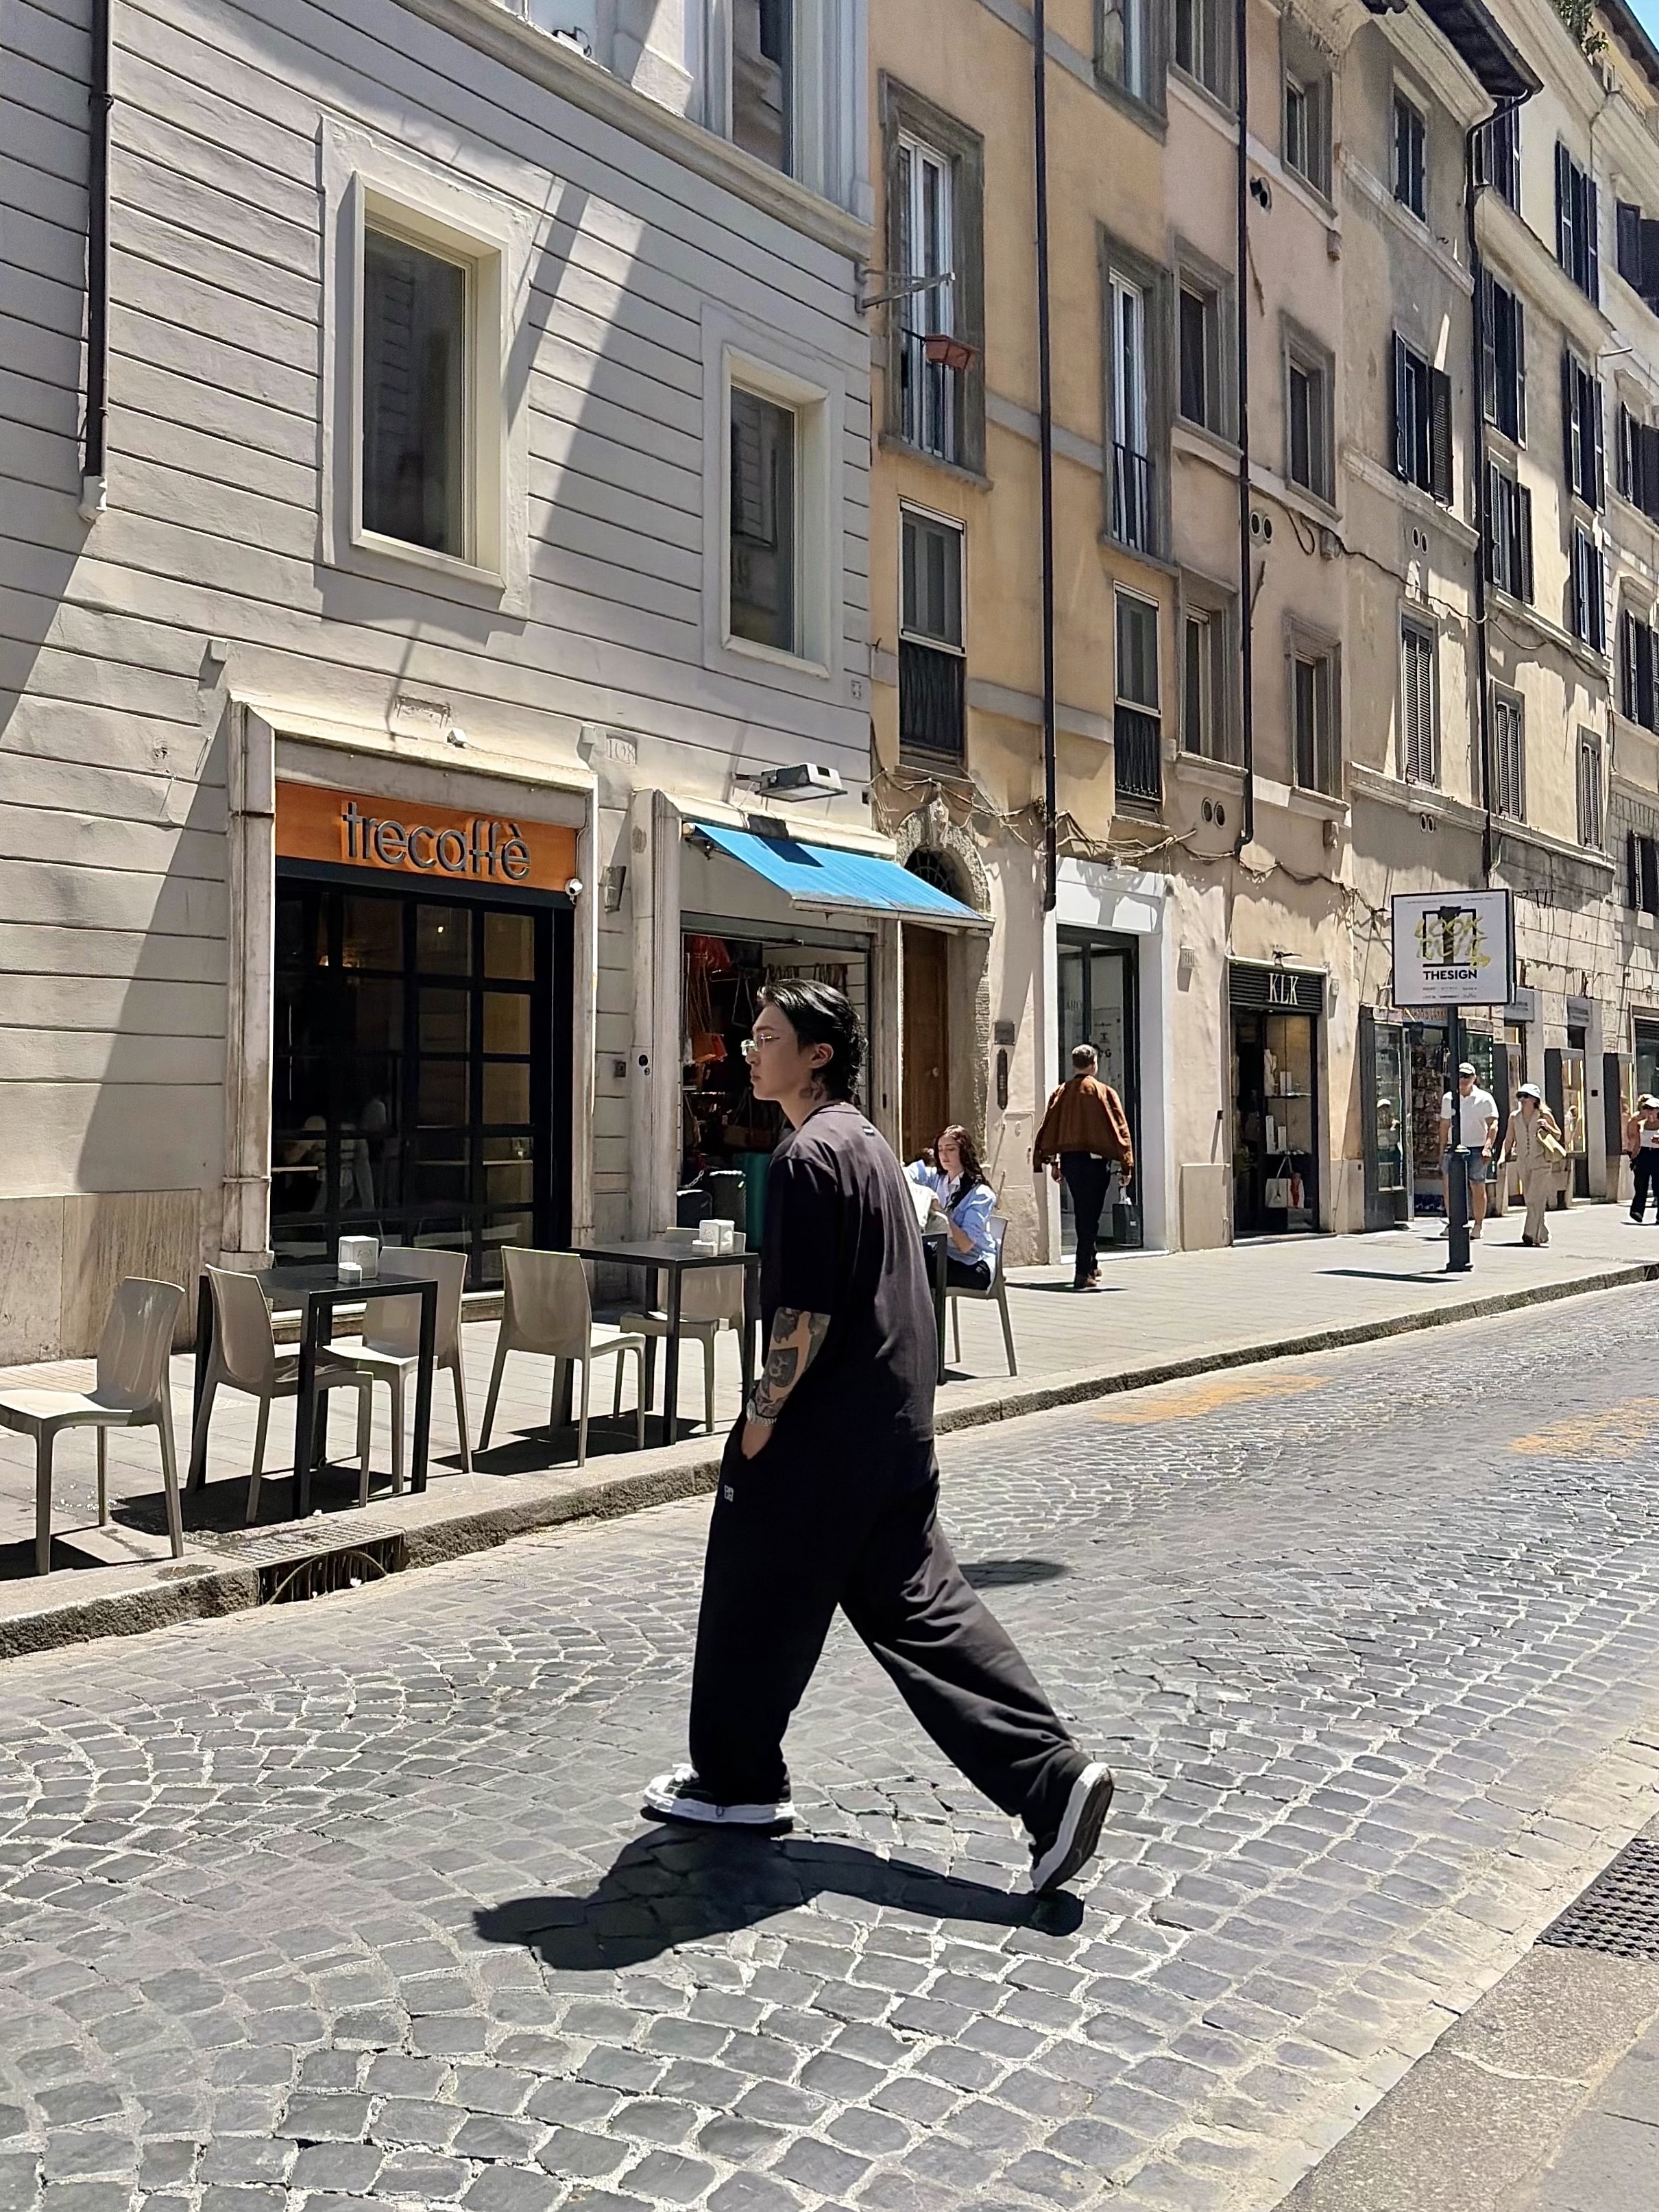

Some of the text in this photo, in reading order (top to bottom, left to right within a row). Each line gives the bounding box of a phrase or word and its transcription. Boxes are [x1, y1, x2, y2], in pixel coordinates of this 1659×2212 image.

[609, 739, 635, 765] 108
[342, 801, 532, 881] trecaffè
[1268, 972, 1300, 1006] KLK
[1422, 969, 1478, 981] THESIGN
